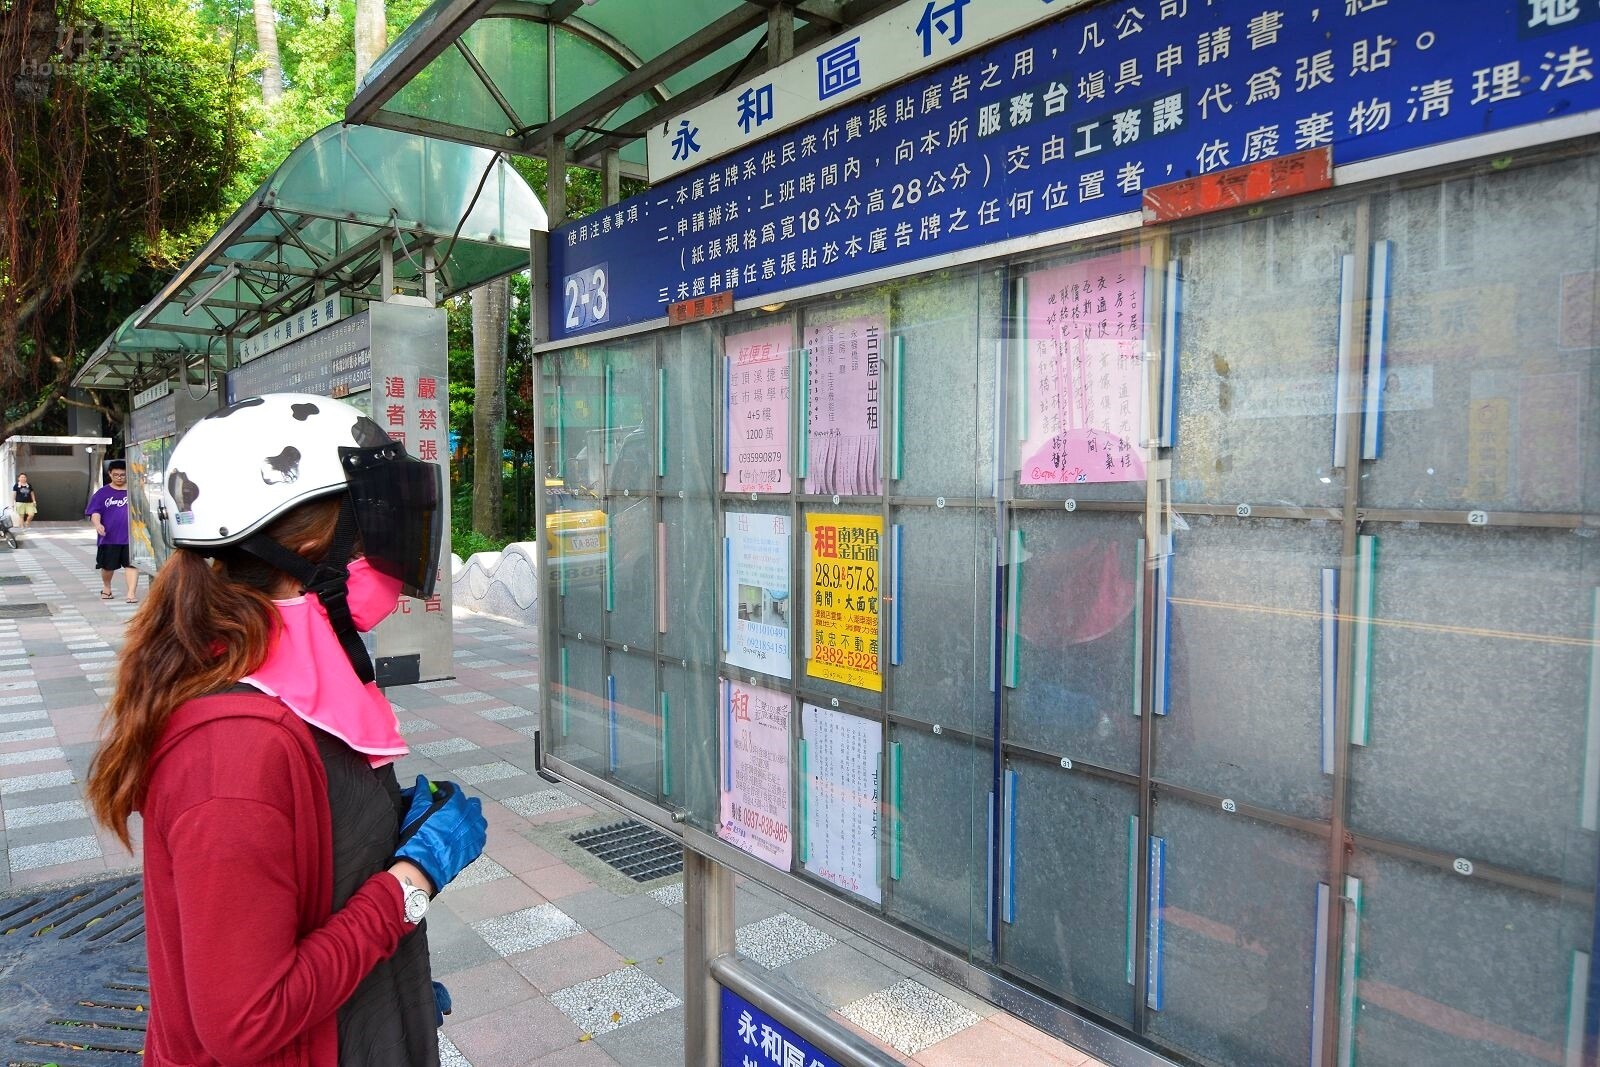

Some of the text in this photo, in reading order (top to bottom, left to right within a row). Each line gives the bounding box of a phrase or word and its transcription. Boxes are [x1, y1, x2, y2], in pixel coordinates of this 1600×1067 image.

[671, 0, 1050, 162] 永和區付
[567, 201, 649, 247] 使用注意事項：
[866, 325, 879, 430] 吉屋出租
[814, 525, 837, 558] 租
[815, 645, 878, 672] 2382-5228
[731, 688, 751, 723] 租
[738, 1010, 824, 1067] 永和區
